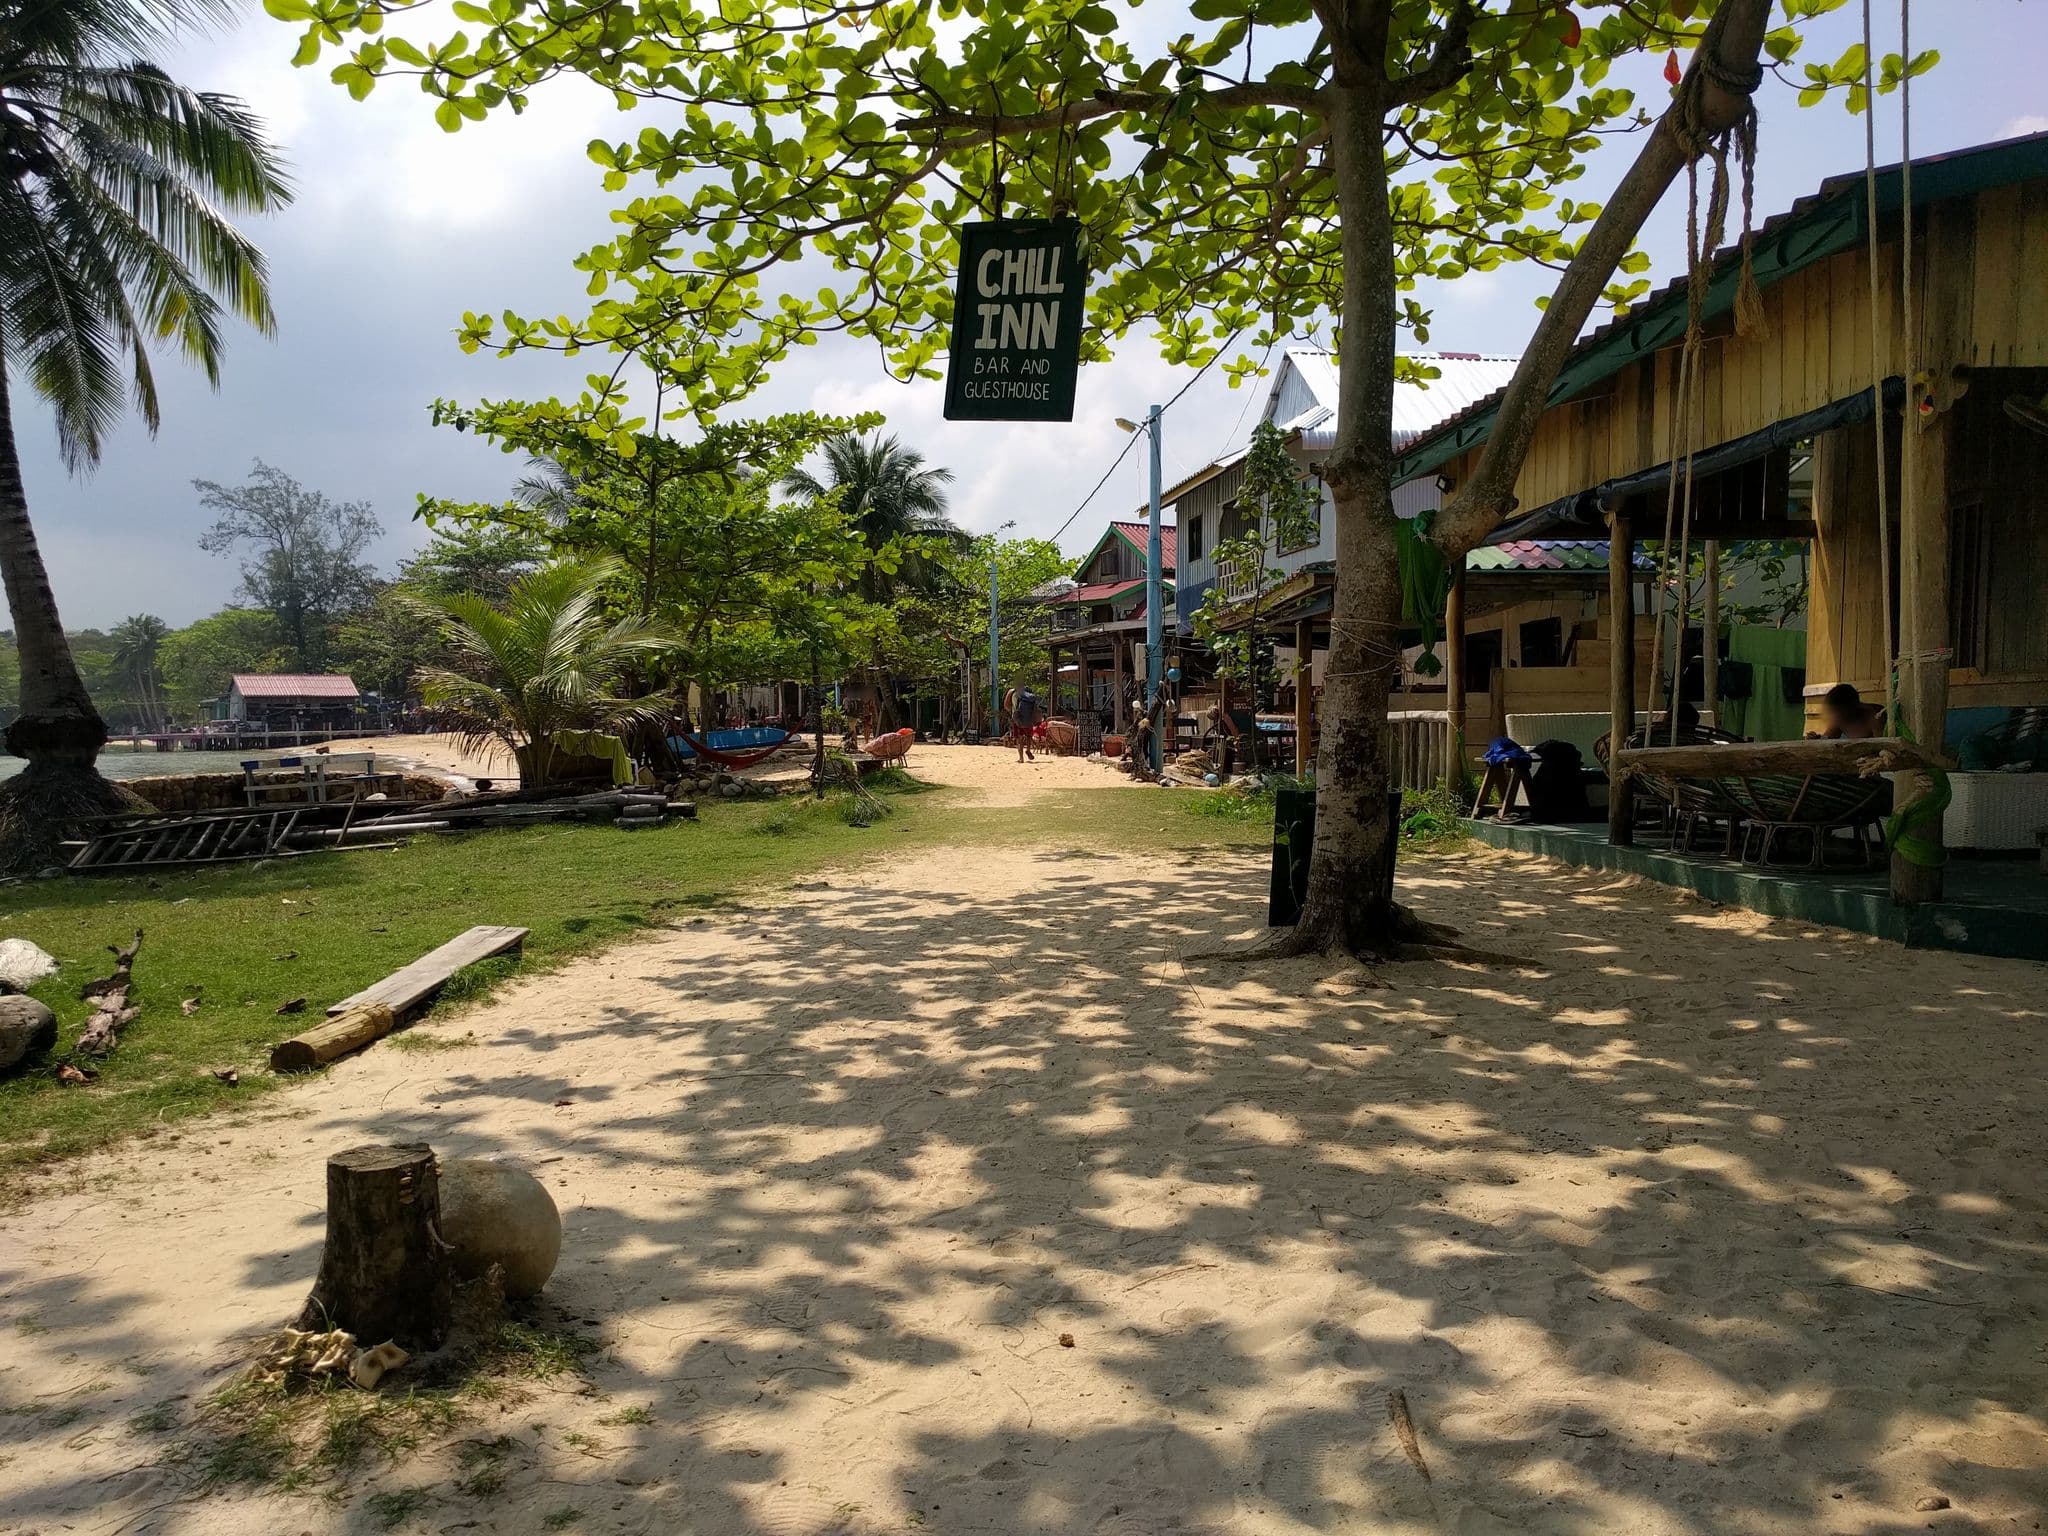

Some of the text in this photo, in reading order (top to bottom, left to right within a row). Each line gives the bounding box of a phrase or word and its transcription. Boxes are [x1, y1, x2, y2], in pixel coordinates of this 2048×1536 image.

[976, 246, 1064, 298] CHILL
[974, 301, 1060, 350] INN
[973, 357, 1050, 375] BAR AND
[964, 381, 1050, 400] GUESTHOUSE
